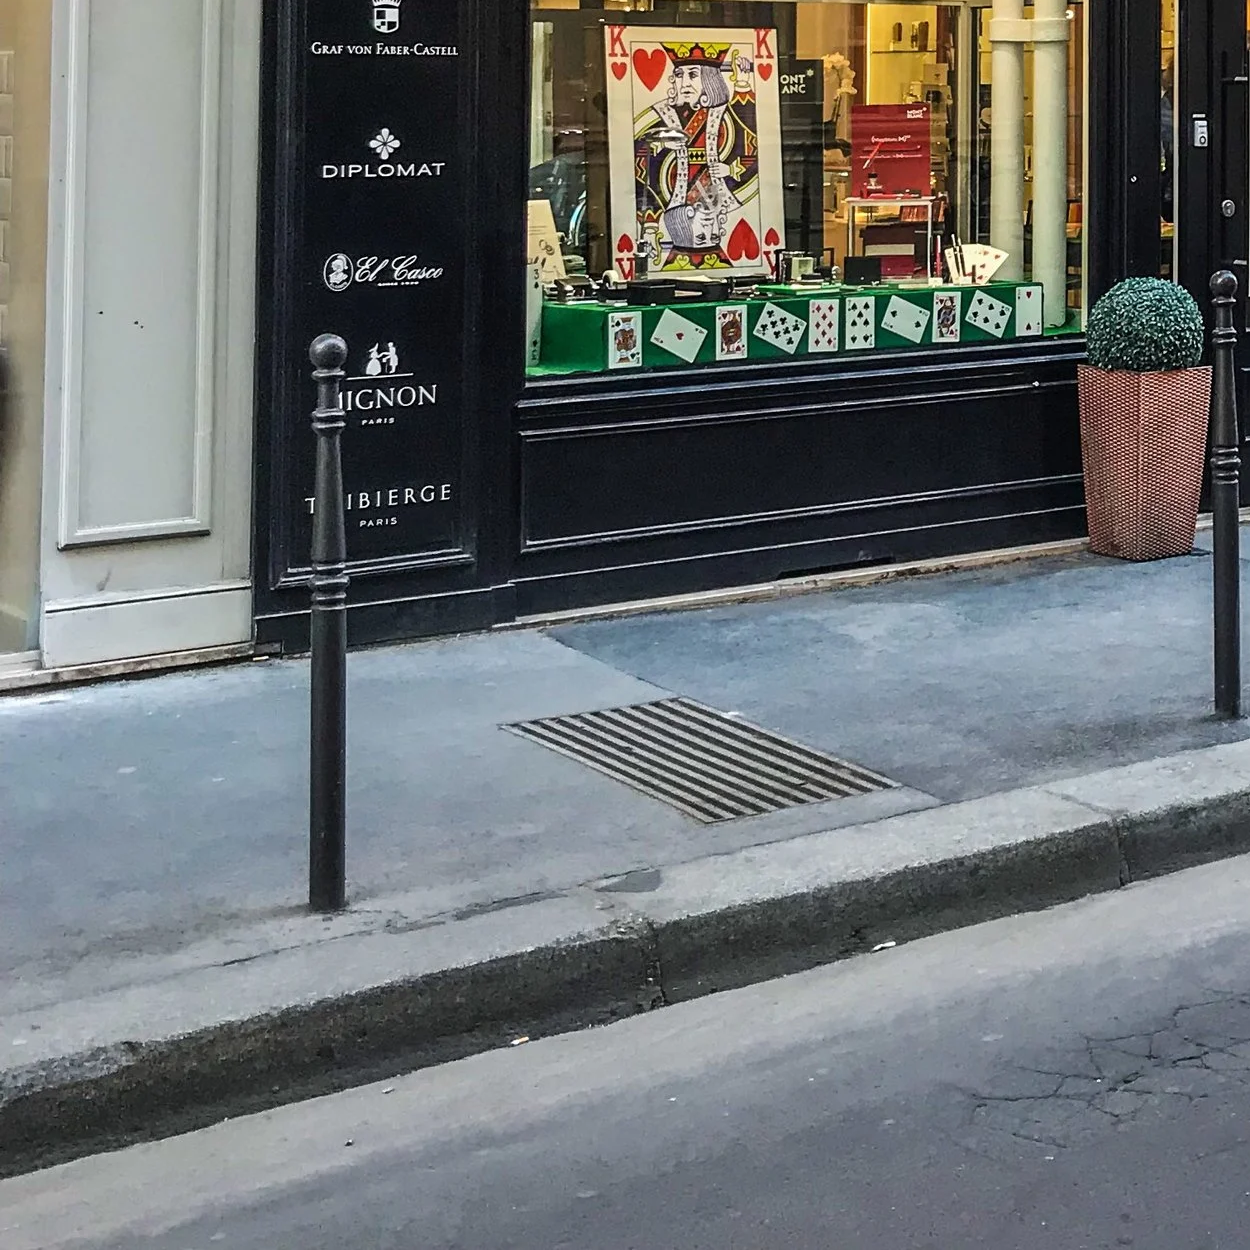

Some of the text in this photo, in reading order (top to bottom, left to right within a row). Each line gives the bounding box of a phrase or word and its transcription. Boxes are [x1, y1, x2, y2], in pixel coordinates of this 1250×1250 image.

[311, 42, 343, 55] GRAF
[608, 24, 629, 57] K
[754, 28, 774, 59] K
[780, 74, 806, 84] ONT
[321, 161, 446, 178] DIPLOMAT
[354, 255, 443, 282] El Casco
[361, 417, 395, 426] PARIS
[305, 484, 451, 515] TIBIERGE
[359, 517, 398, 527] PARIS
